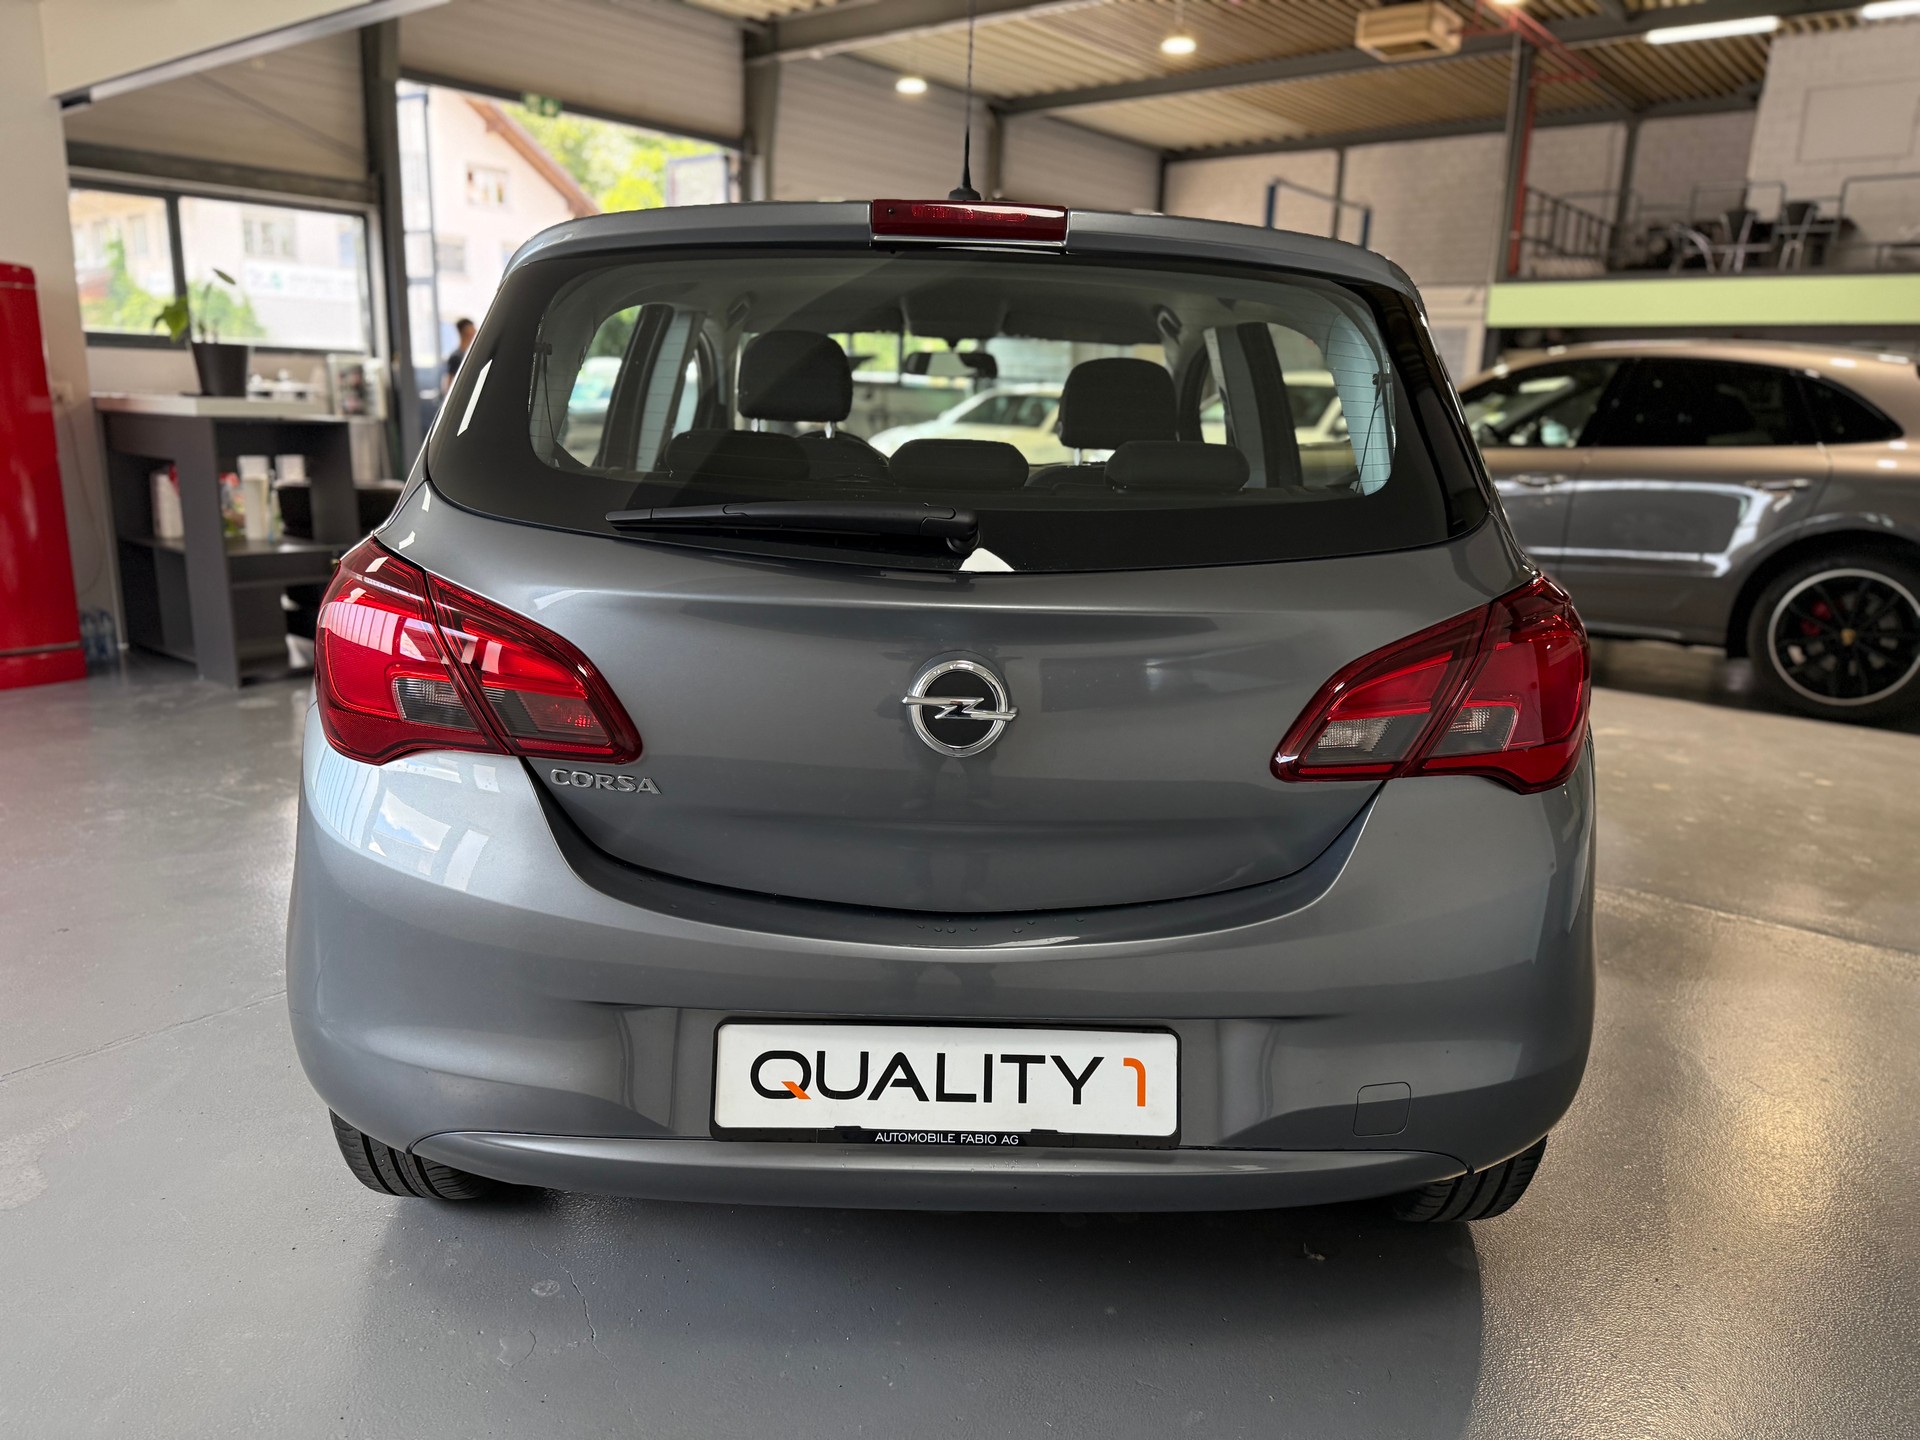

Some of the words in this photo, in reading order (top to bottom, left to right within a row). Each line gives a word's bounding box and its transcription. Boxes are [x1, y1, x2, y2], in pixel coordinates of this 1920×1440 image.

[550, 768, 661, 795] CORSA
[750, 1050, 1104, 1105] QUALITY
[1123, 1057, 1146, 1107] 1
[874, 1132, 955, 1144] AUTOMOBILE
[960, 1133, 997, 1145] FABIO
[1001, 1134, 1019, 1145] AG
